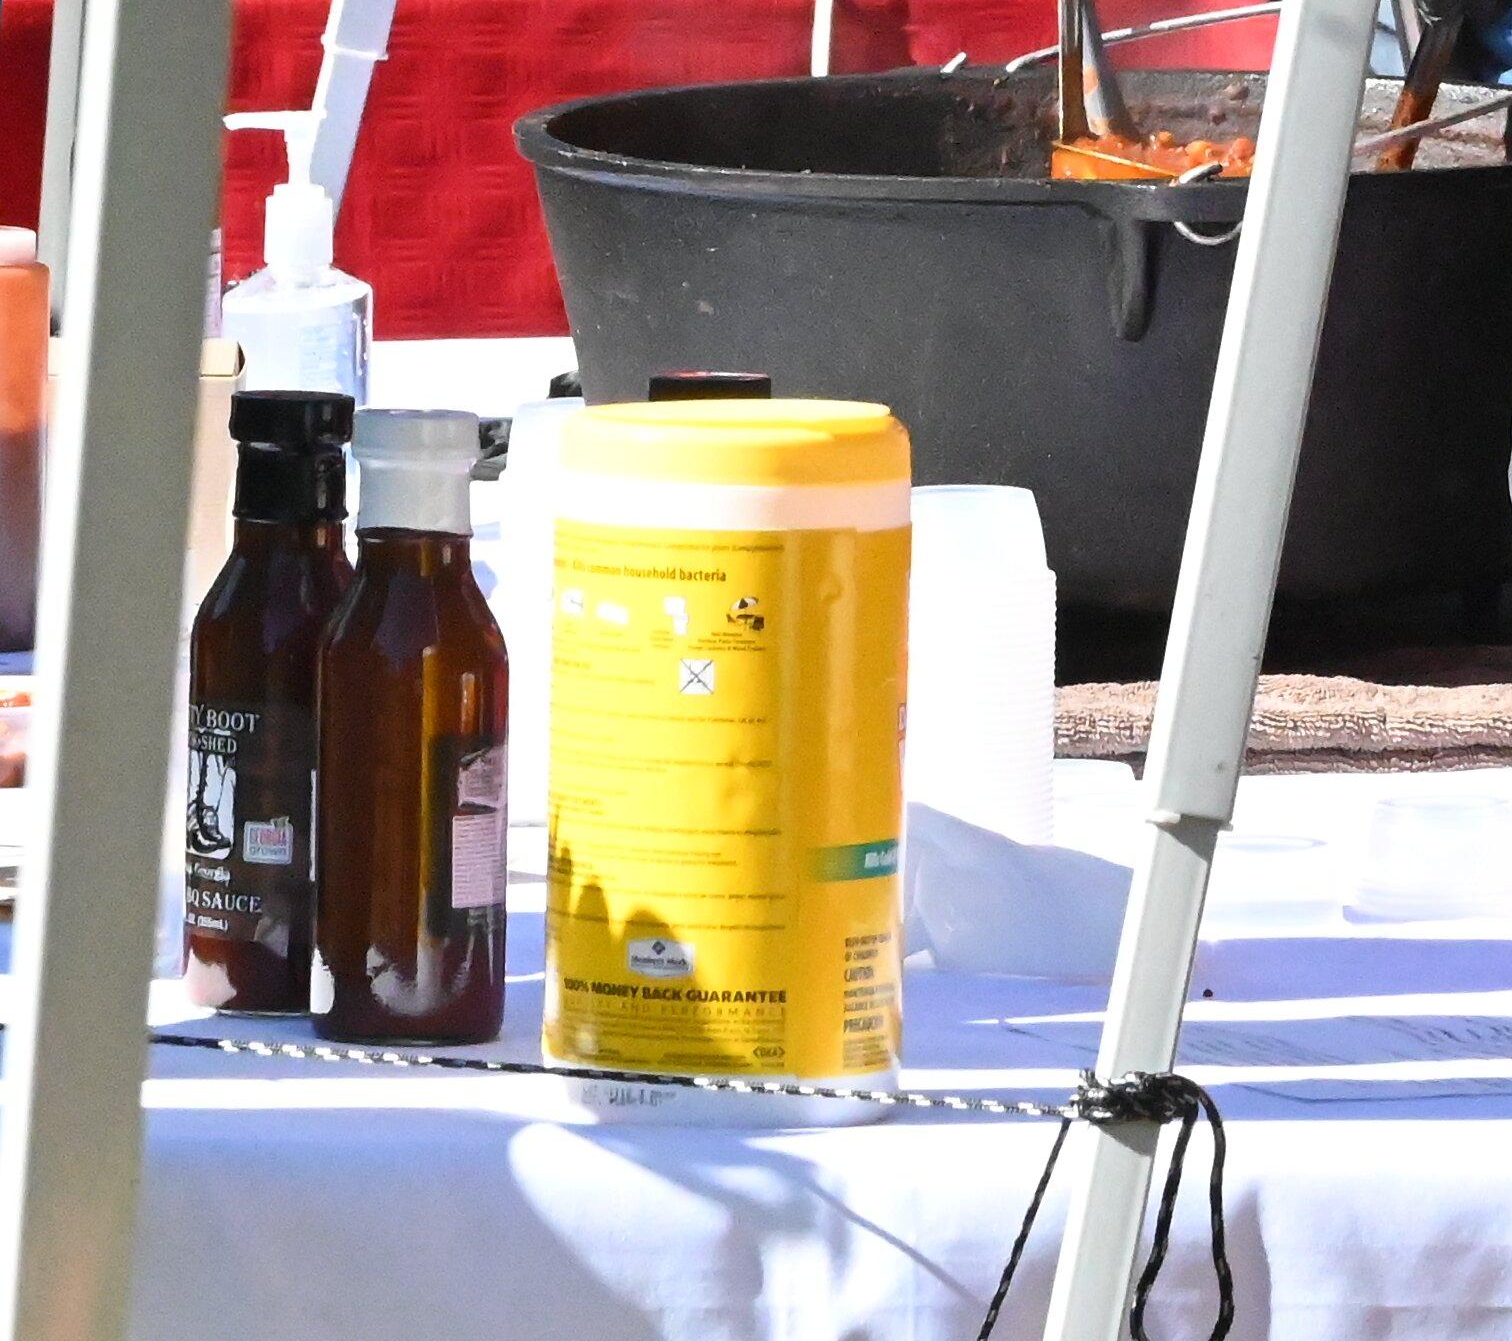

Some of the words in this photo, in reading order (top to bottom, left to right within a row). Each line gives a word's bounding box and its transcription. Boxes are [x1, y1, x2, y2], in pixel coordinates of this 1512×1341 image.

[624, 565, 676, 580] household
[679, 568, 726, 582] bacteria
[206, 709, 261, 734] BOOT
[201, 890, 263, 914] SAUCE
[564, 977, 589, 993] 100%
[592, 982, 637, 999] MONEY
[642, 986, 682, 1002] BACK
[685, 989, 787, 1004] GUARANTEE
